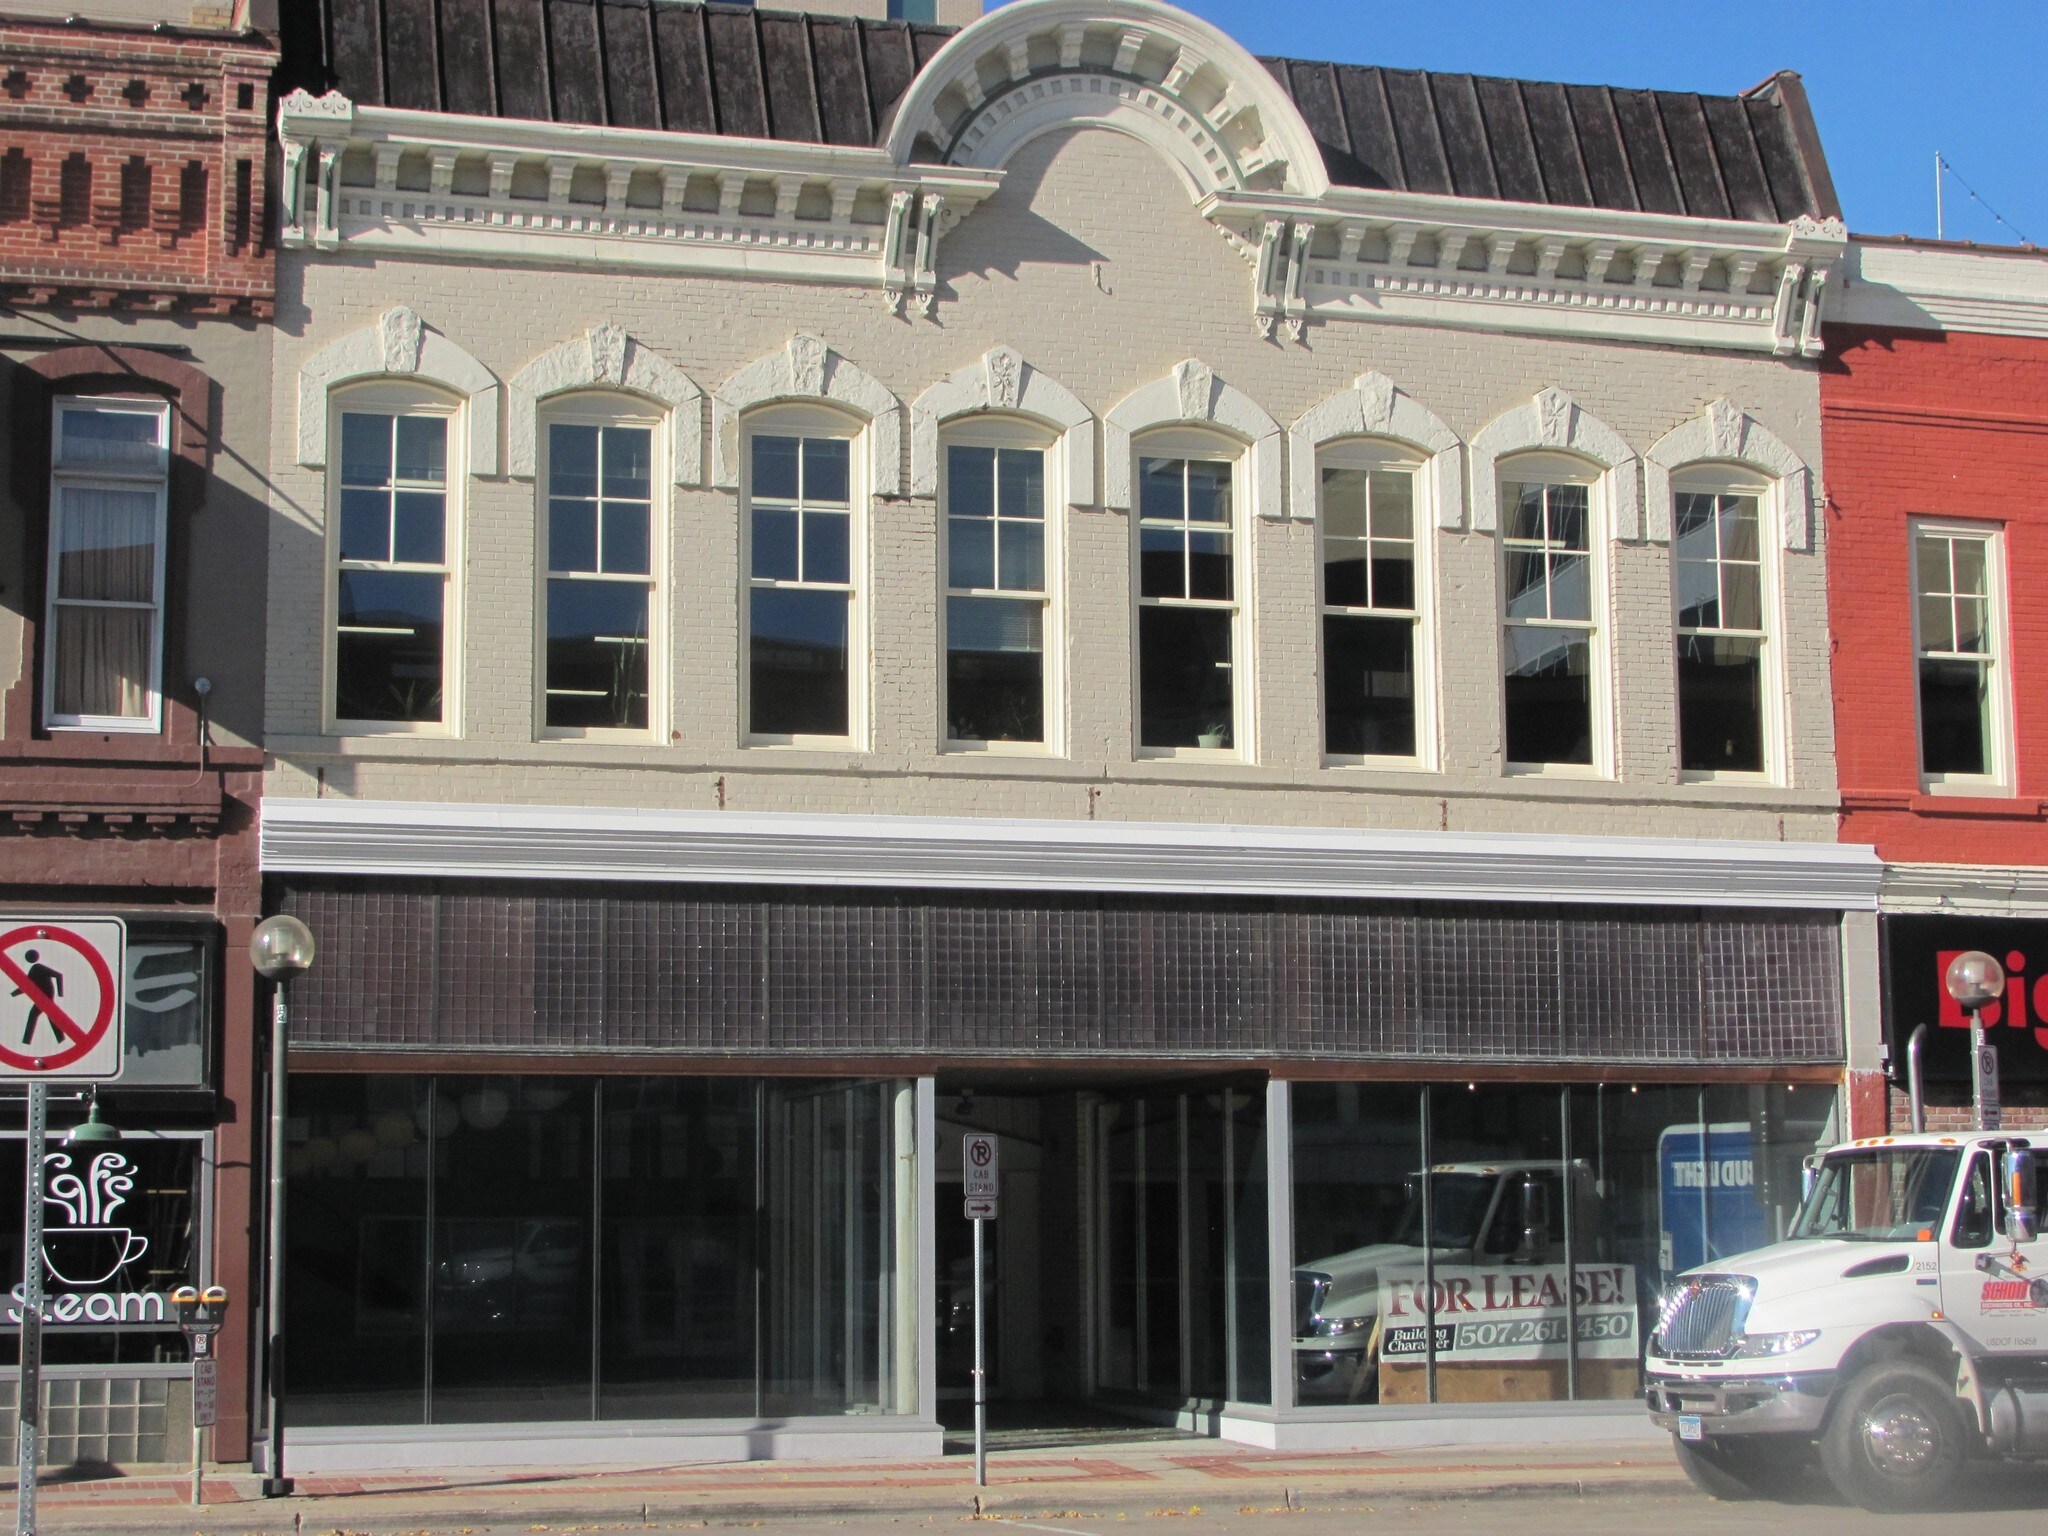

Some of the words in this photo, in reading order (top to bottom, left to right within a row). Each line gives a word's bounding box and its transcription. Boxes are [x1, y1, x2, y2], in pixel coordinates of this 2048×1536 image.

[973, 1170, 989, 1179] CAB
[969, 1183, 994, 1192] STAND
[1915, 1261, 1938, 1271] 2152
[1387, 1277, 1478, 1318] FOR
[1480, 1268, 1627, 1311] LEASE!
[1393, 1328, 1447, 1341] Buildng
[1459, 1314, 1629, 1348] 507.261.450
[1388, 1339, 1450, 1352] Charaer
